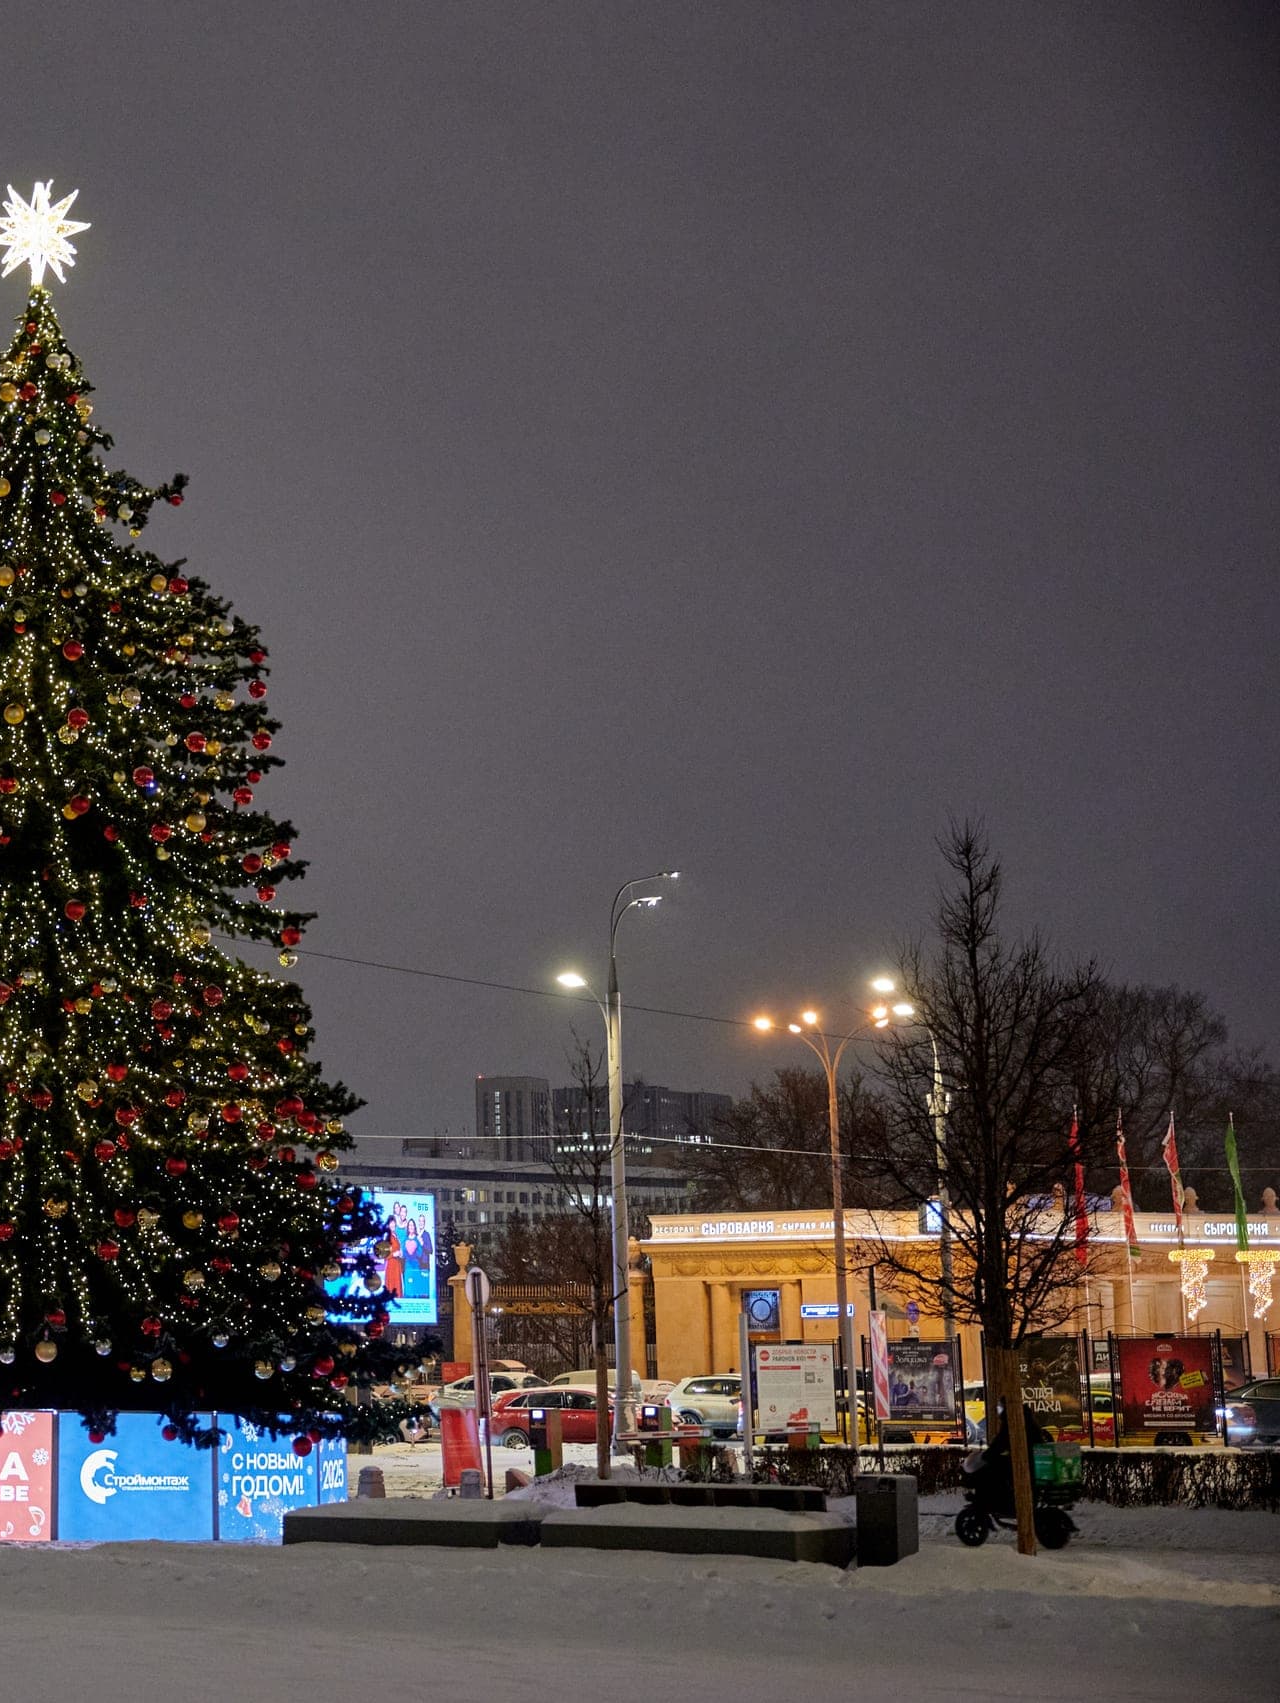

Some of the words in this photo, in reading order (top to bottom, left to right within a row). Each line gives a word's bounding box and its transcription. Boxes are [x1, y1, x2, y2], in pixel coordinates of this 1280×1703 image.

[417, 1203, 429, 1212] ВТБ
[654, 1225, 694, 1234] РЕСТОРАН
[701, 1221, 774, 1236] СЫРОВАРНЯ
[782, 1222, 816, 1230] СЫРНАЯ
[232, 1453, 244, 1470] С
[246, 1453, 304, 1470] НОВЫМ
[104, 1474, 189, 1487] Строймонтаж
[322, 1459, 345, 1491] 2025
[232, 1475, 305, 1499] ГОДОМ!
